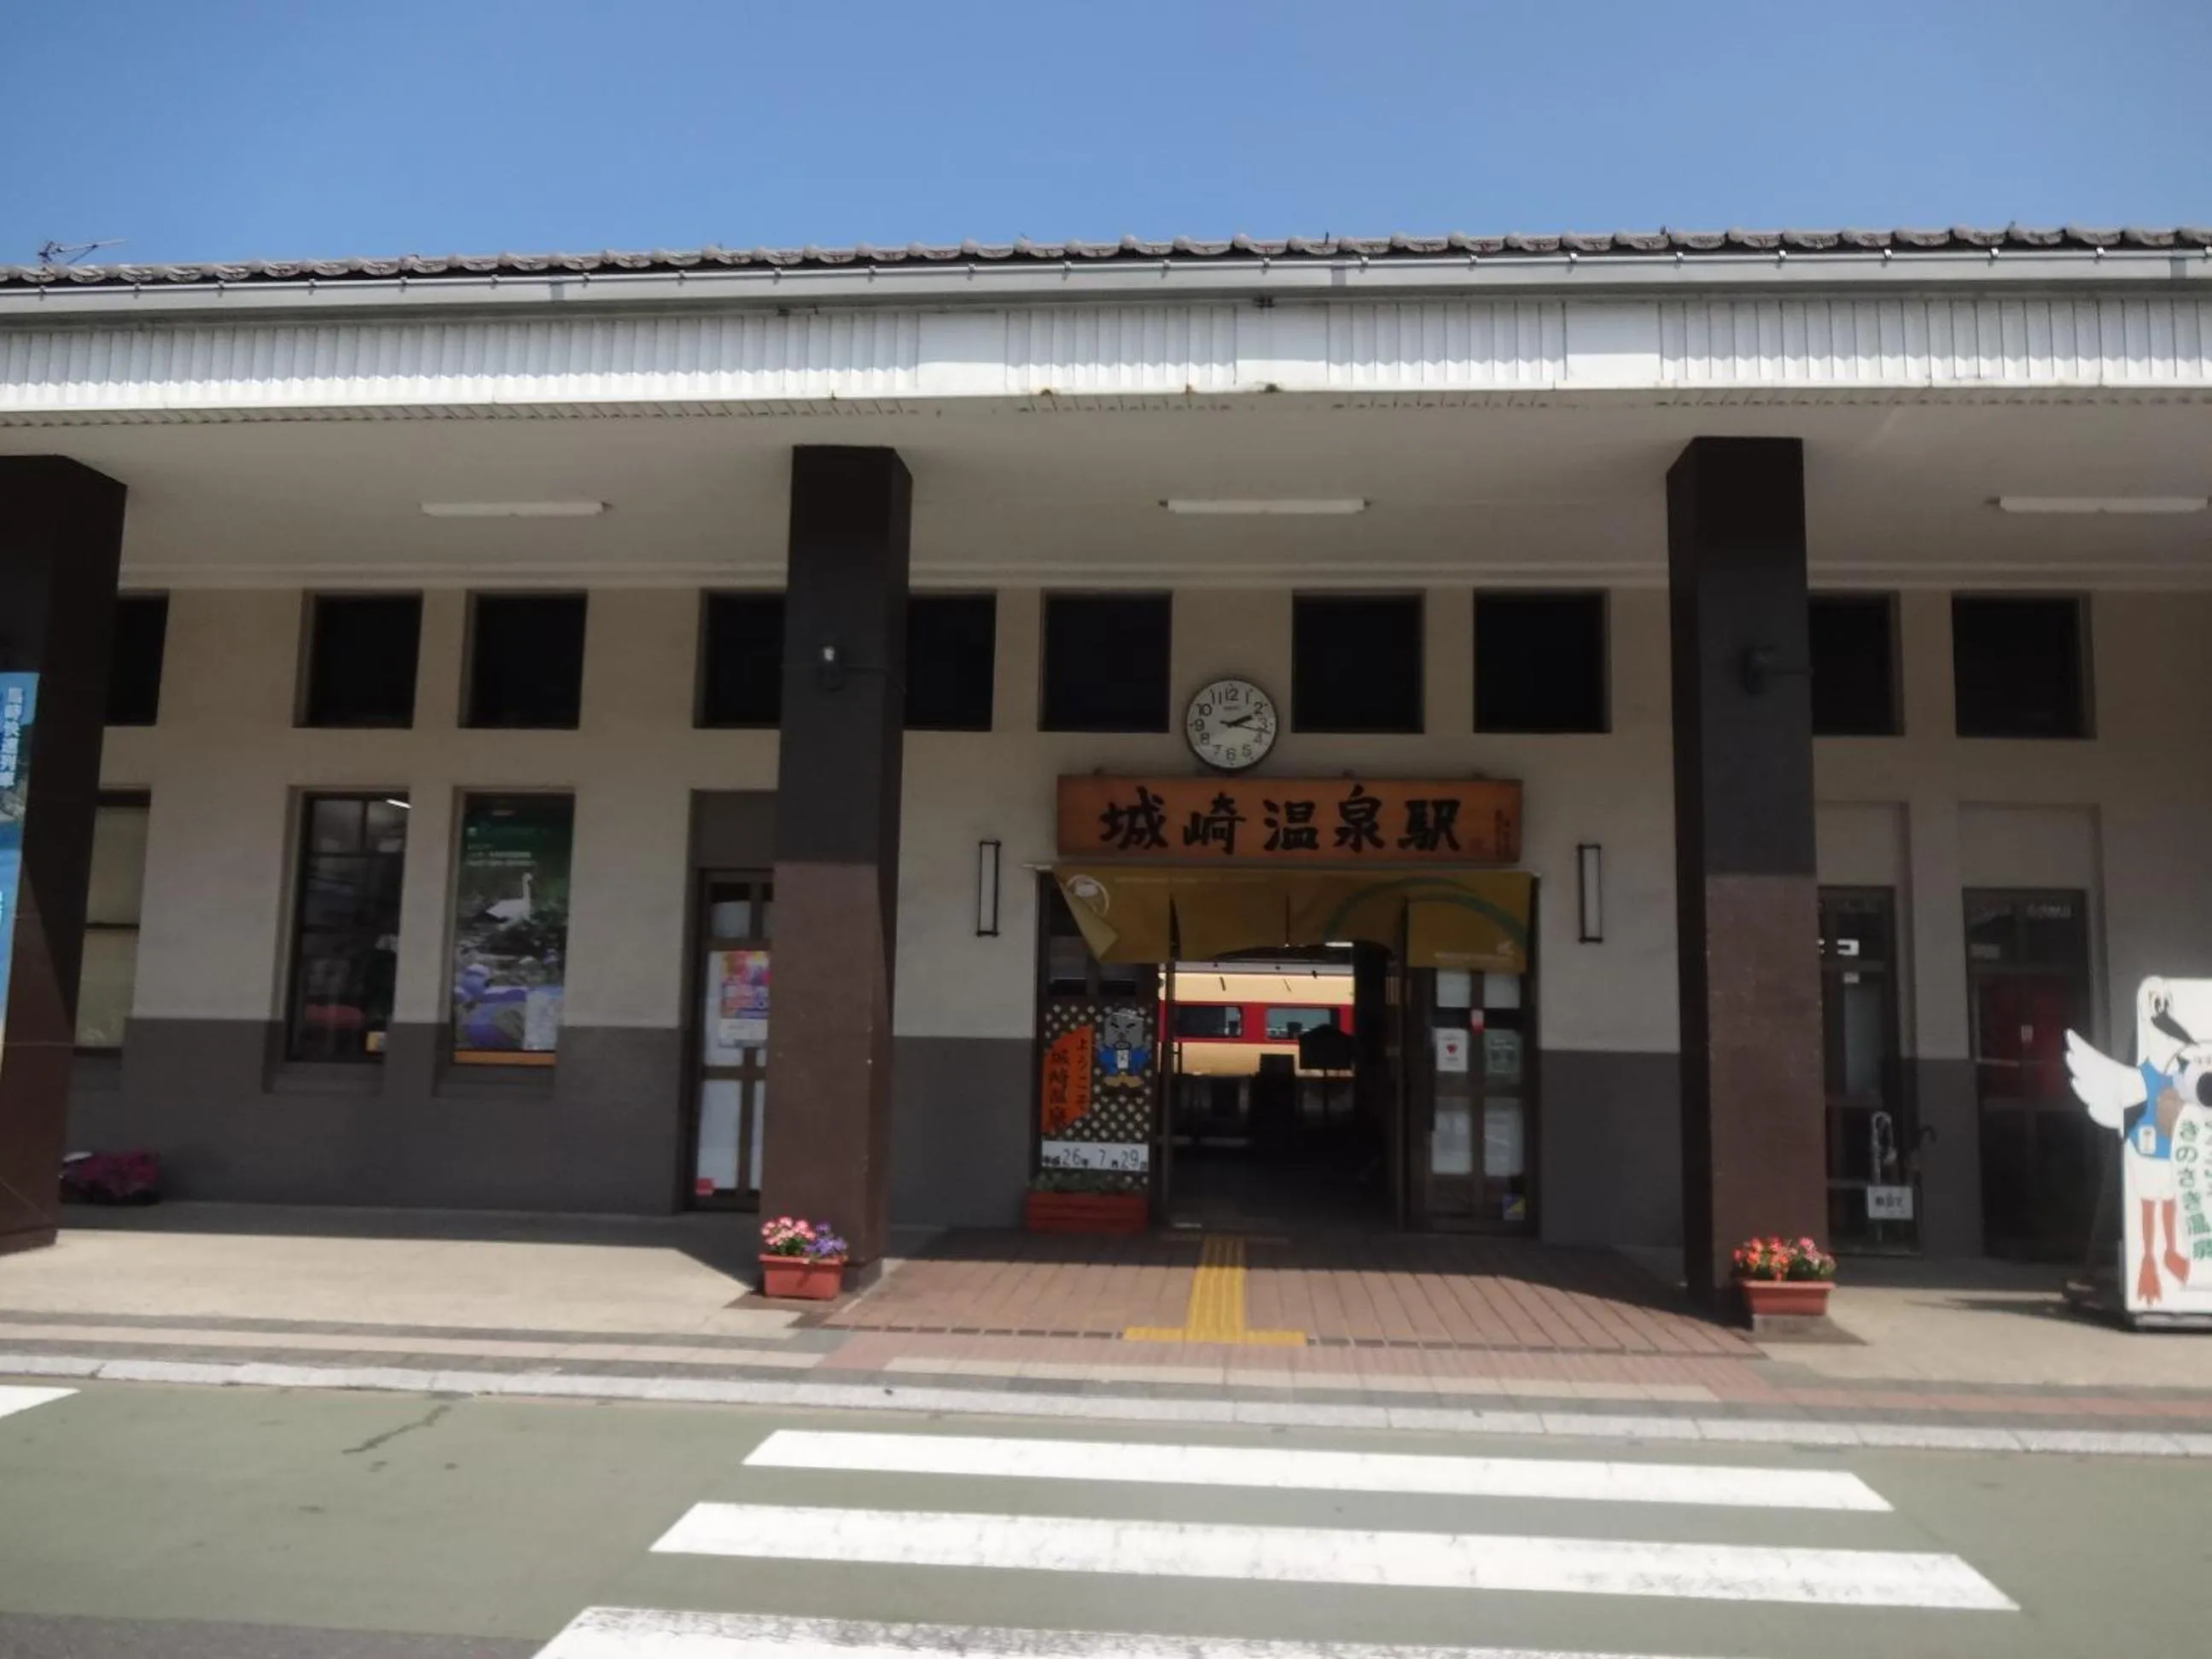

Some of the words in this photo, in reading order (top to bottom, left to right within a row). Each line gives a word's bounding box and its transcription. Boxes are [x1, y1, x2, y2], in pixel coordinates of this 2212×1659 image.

[1211, 690, 1222, 704] 11
[1225, 687, 1239, 701] 12
[1197, 702, 1212, 716] 10
[1254, 701, 1263, 714] 2
[1194, 719, 1204, 731] 9
[1258, 718, 1267, 728] 3
[1201, 733, 1209, 744] 8
[1226, 748, 1236, 761] 6
[1098, 783, 1462, 853] 城崎温泉駅
